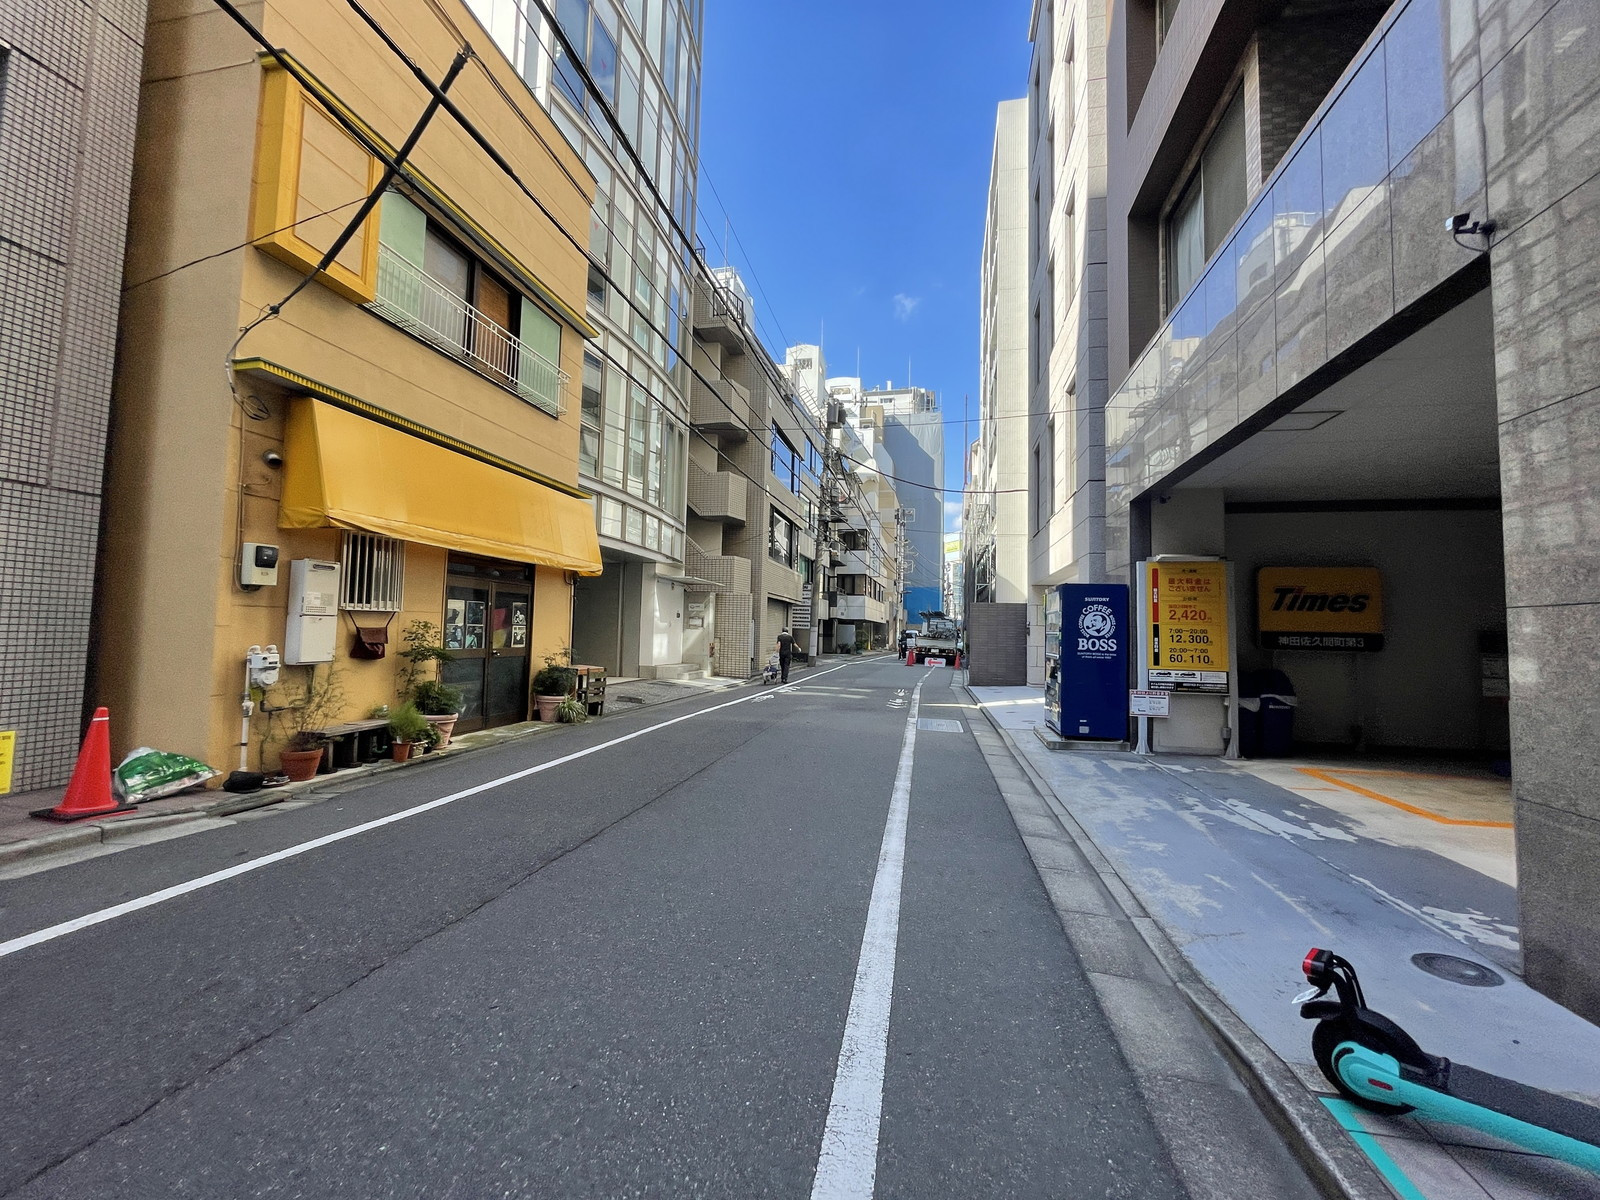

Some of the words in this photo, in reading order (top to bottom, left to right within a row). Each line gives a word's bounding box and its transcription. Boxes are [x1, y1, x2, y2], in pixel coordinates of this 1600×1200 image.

[1272, 586, 1370, 612] Times
[1082, 604, 1112, 615] COFFEE
[1077, 638, 1117, 651] BOSS
[1278, 636, 1364, 647] 神田佐久間町第3
